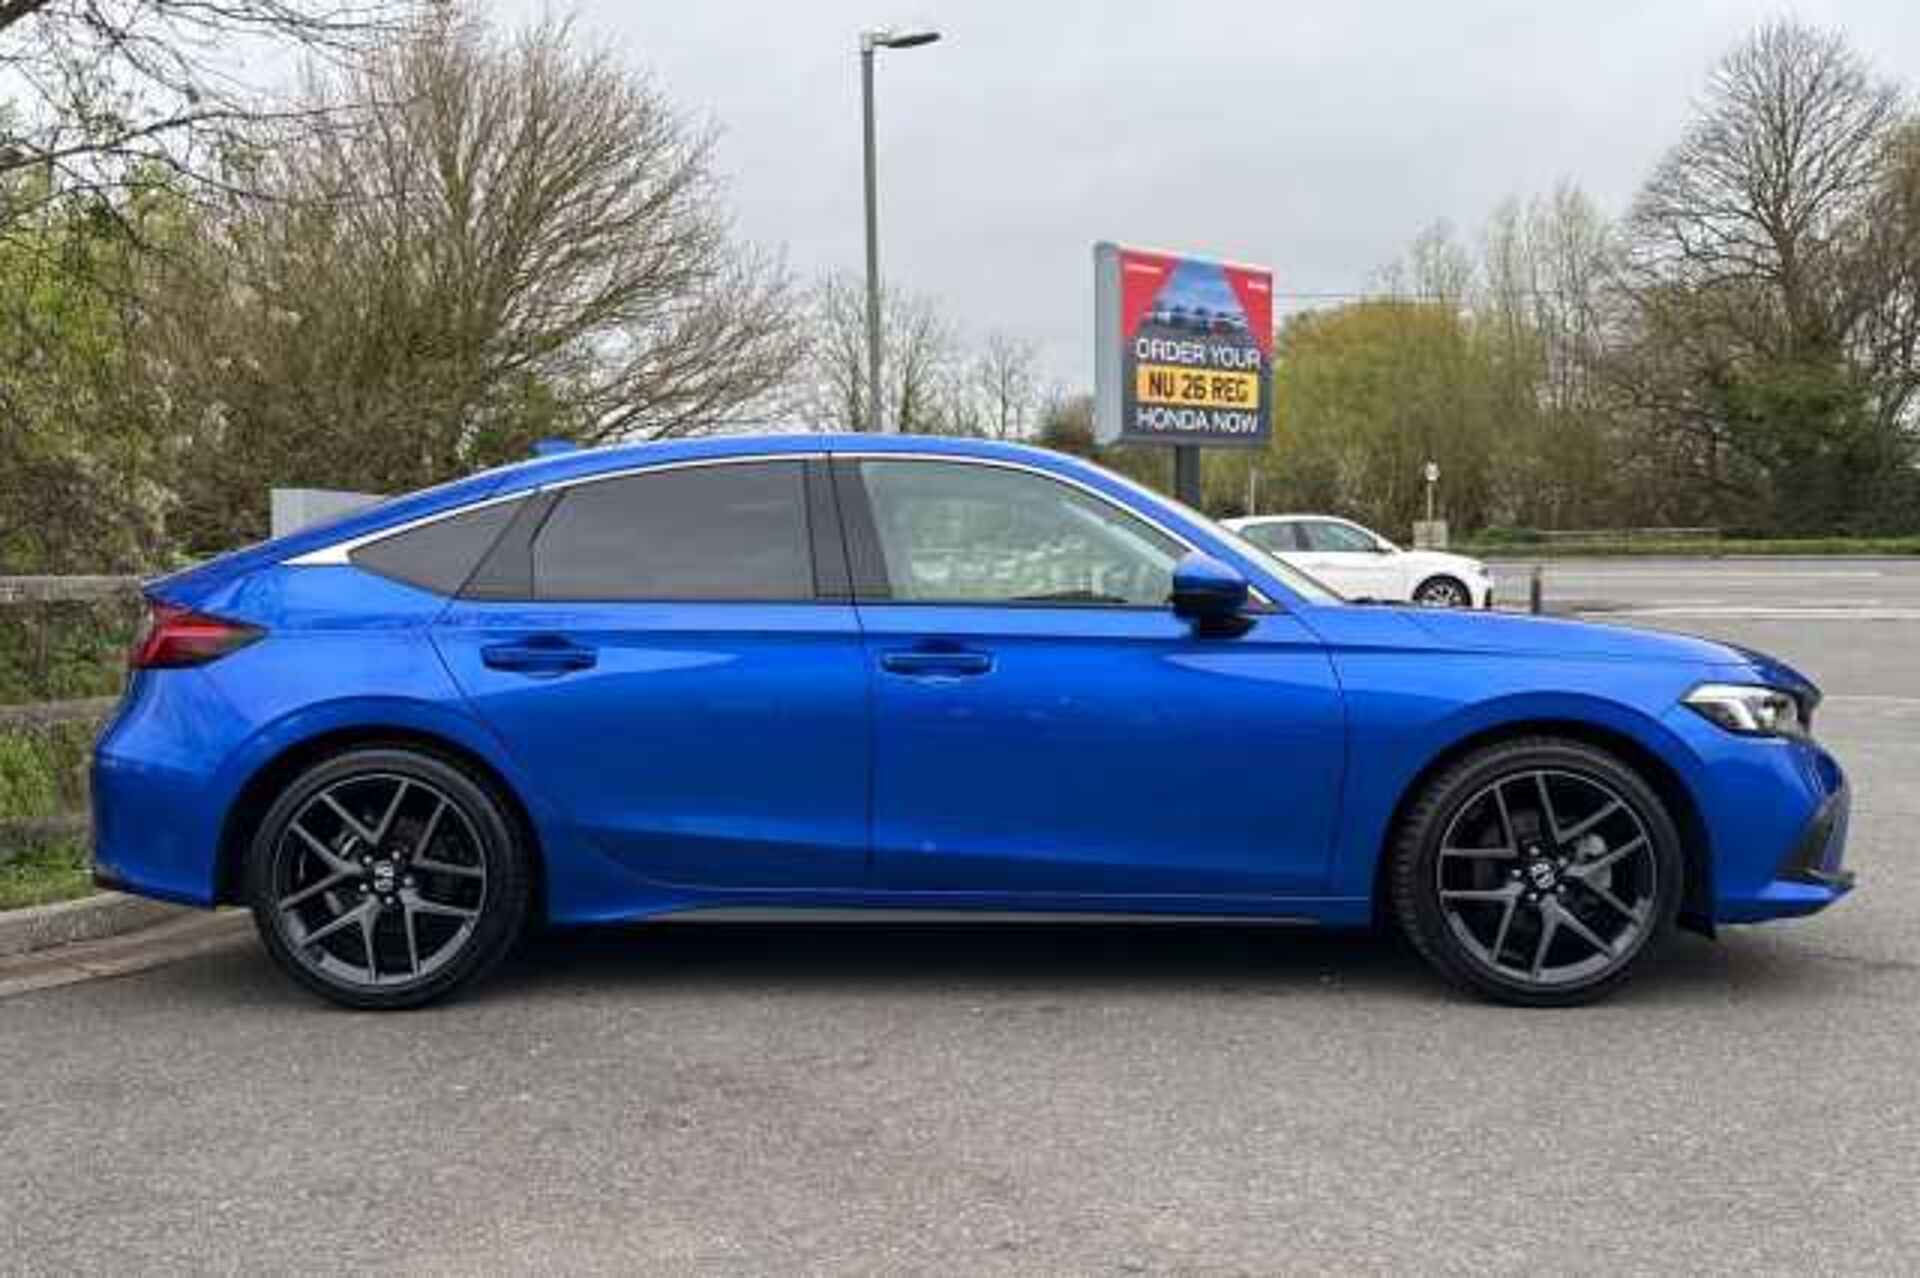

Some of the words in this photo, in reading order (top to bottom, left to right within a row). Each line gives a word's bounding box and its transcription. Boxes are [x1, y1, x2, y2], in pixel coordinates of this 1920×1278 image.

[1136, 338, 1205, 364] ORDER
[1212, 346, 1260, 367] YOUR
[1149, 371, 1175, 397] NU
[1181, 374, 1206, 400] 26
[1212, 377, 1249, 402] REG
[1136, 407, 1209, 431] HONDA
[1213, 411, 1258, 433] NOW
